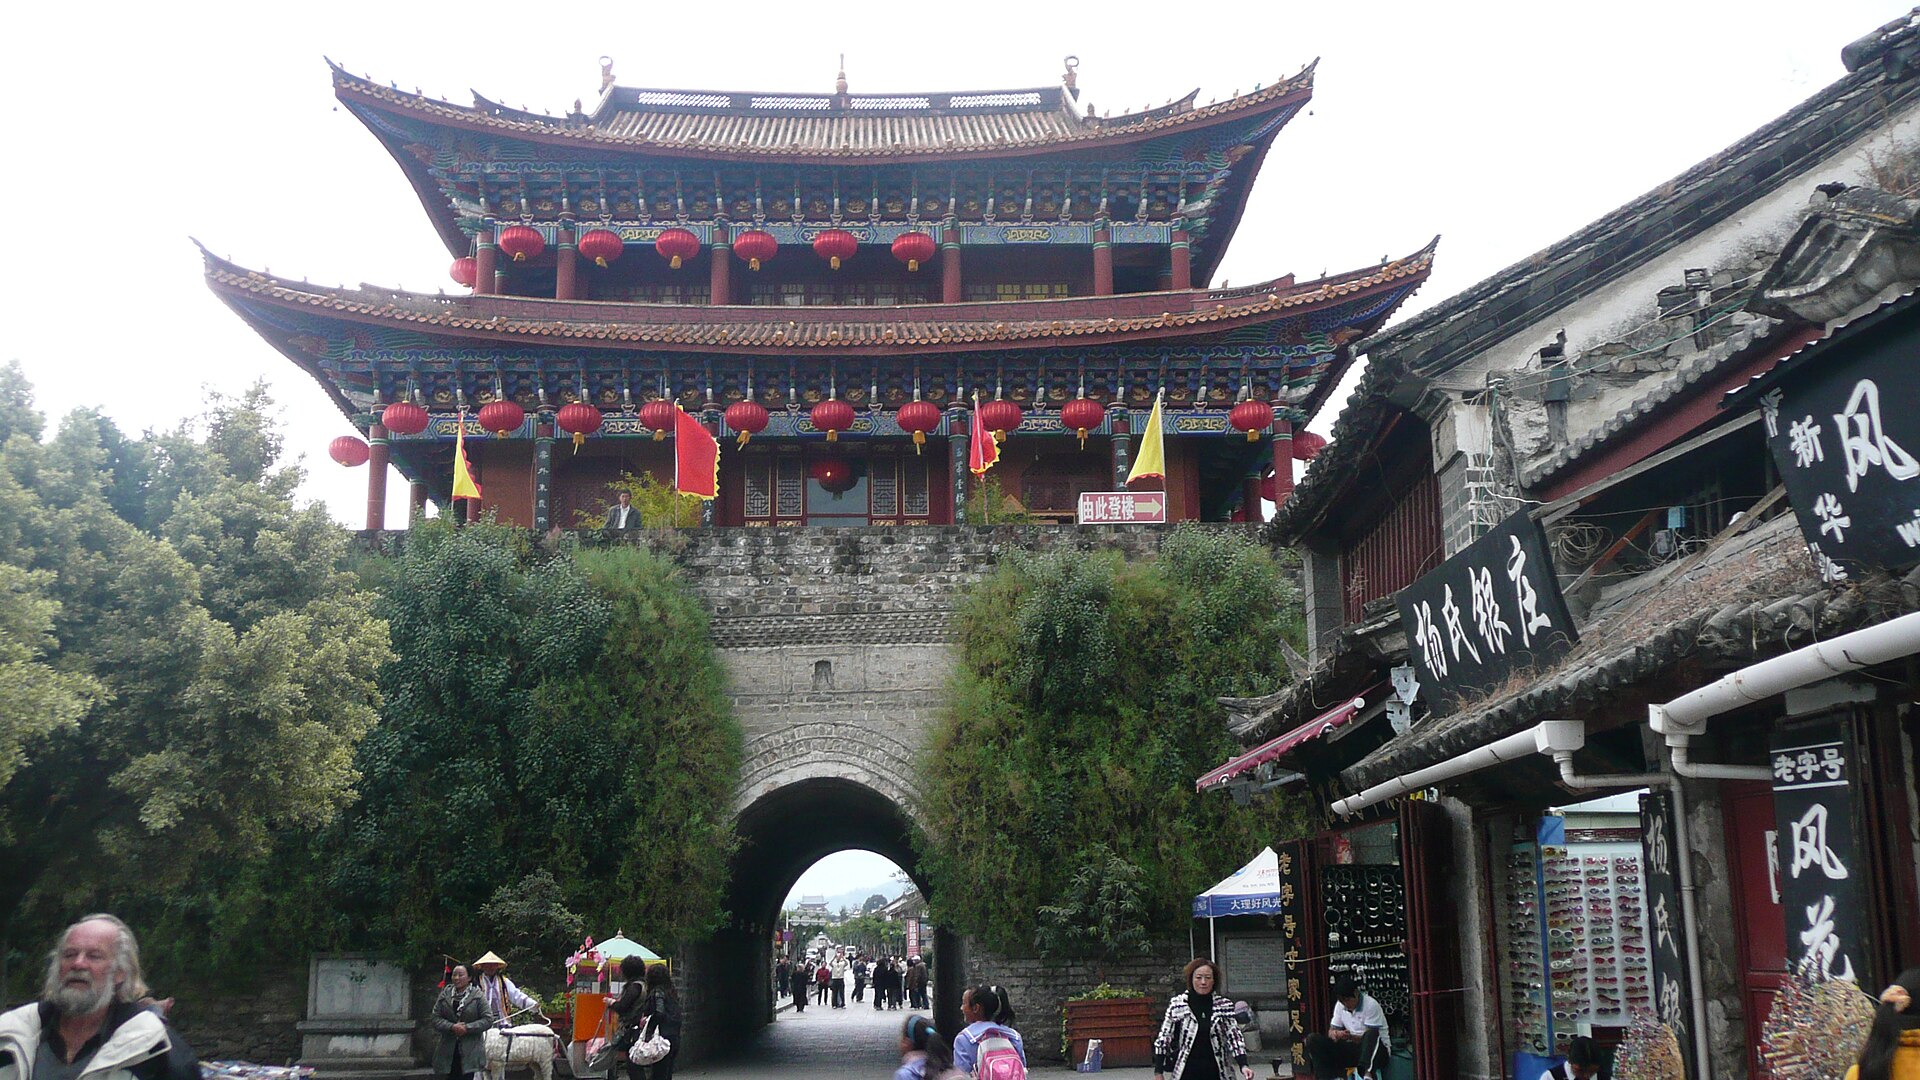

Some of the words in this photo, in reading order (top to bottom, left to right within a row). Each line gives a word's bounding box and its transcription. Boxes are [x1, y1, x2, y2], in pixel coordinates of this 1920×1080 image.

[1833, 379, 1920, 492] 风
[1083, 496, 1134, 520] 由此登楼
[1413, 535, 1552, 682] 杨氏银庄
[1774, 748, 1845, 782] 老字号
[1230, 897, 1281, 910] 大理好风光
[1791, 803, 1856, 982] 风花
